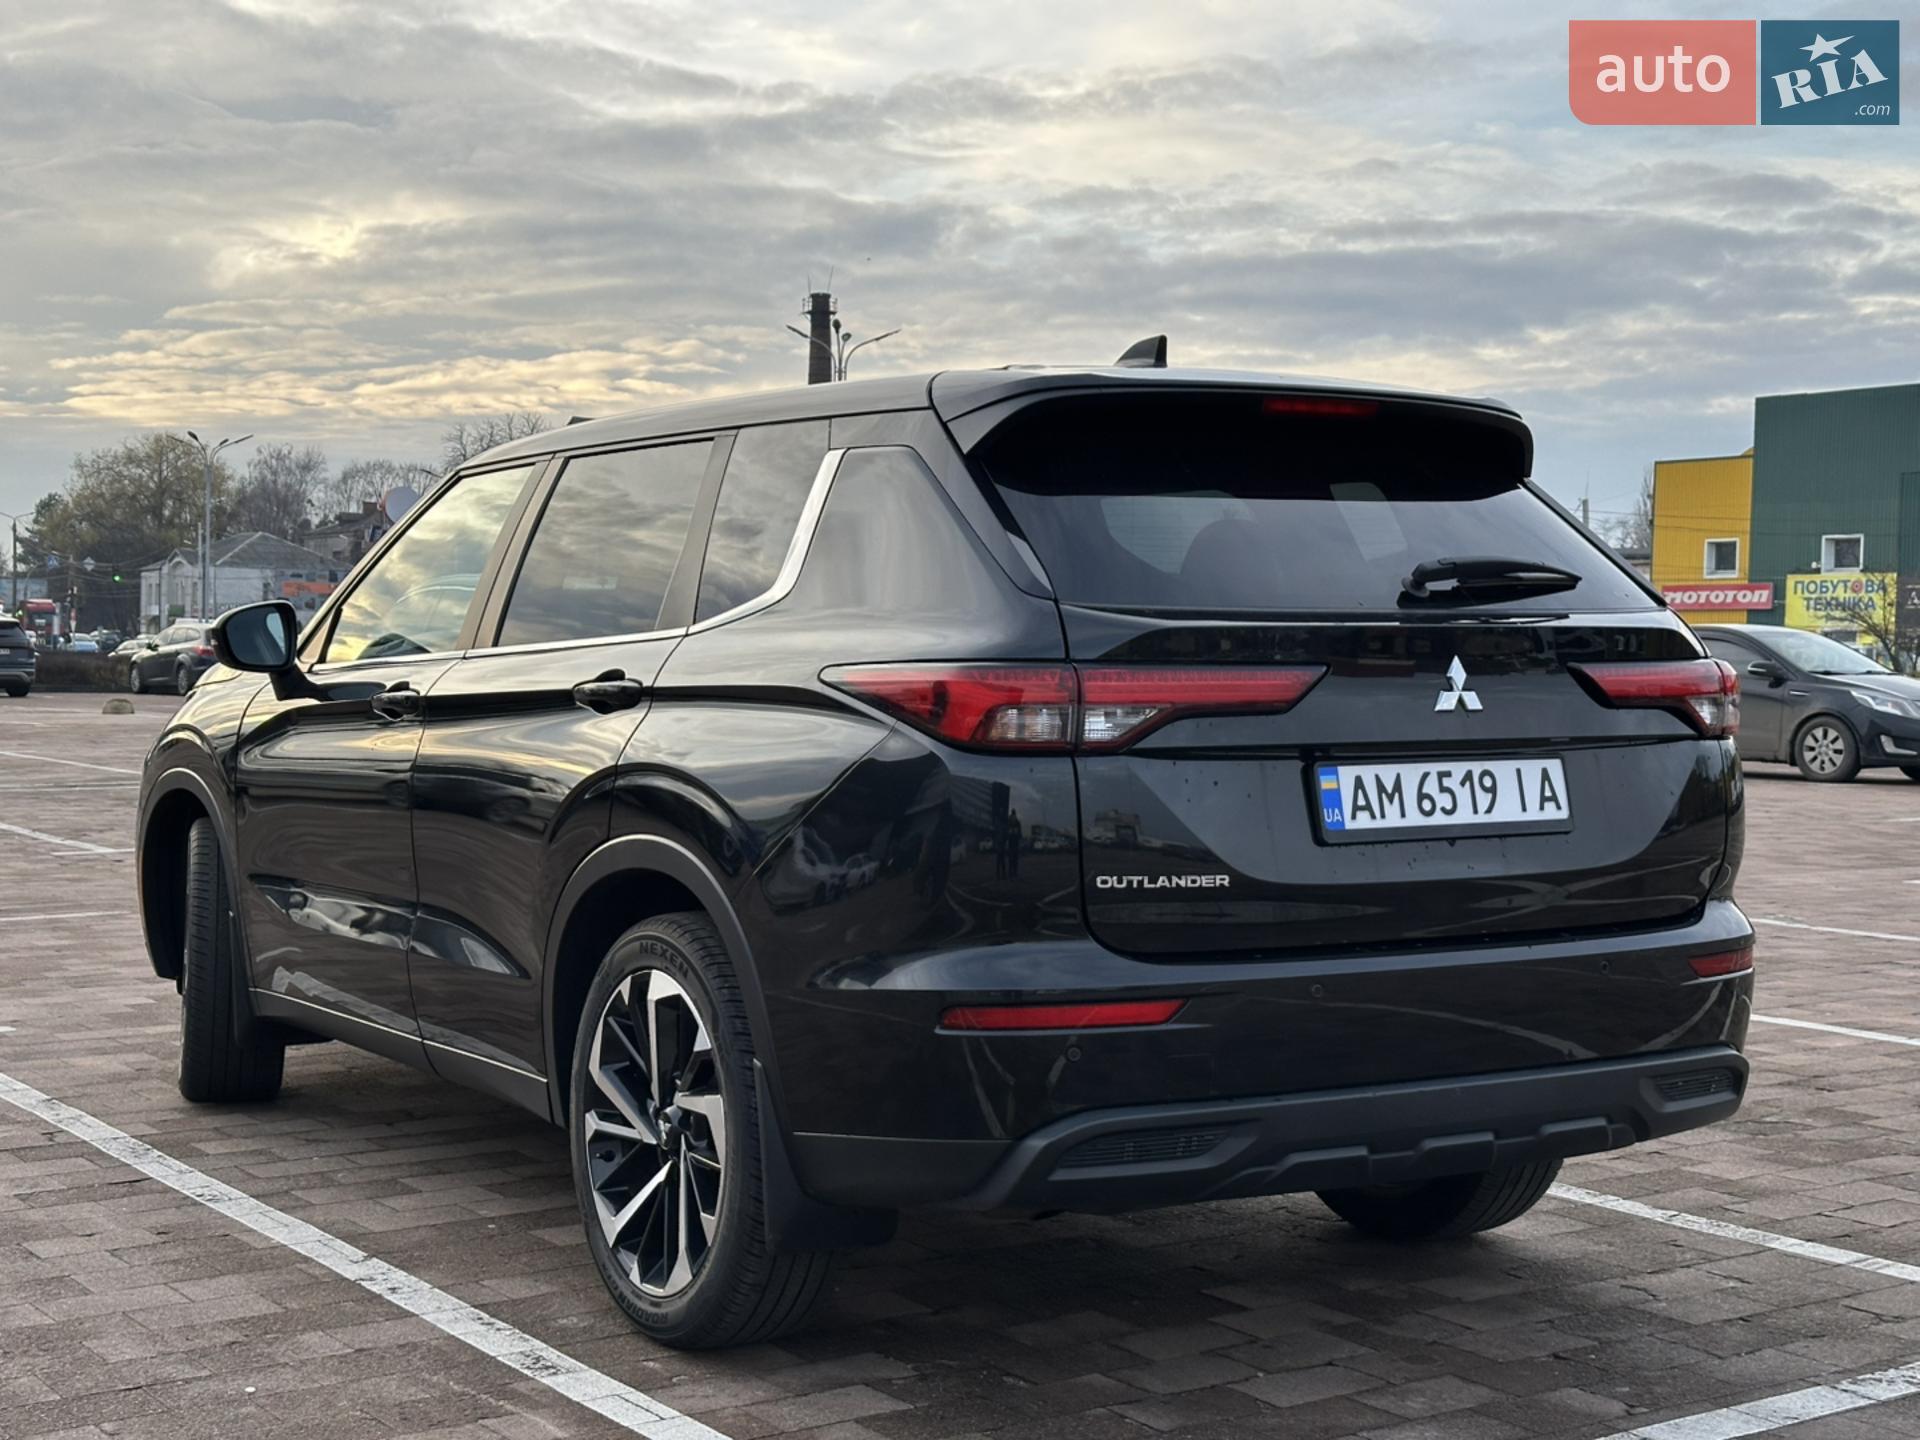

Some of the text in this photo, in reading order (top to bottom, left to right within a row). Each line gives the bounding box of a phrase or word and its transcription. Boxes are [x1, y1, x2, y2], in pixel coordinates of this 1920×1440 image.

[1794, 579, 1887, 595] ПОБУТОВА
[1803, 596, 1877, 612] ТЕХНІКА
[1350, 766, 1562, 820] AM 6519 IA
[1324, 808, 1343, 823] UA
[1096, 875, 1230, 888] OUTLANDER
[639, 941, 689, 979] NEXEN
